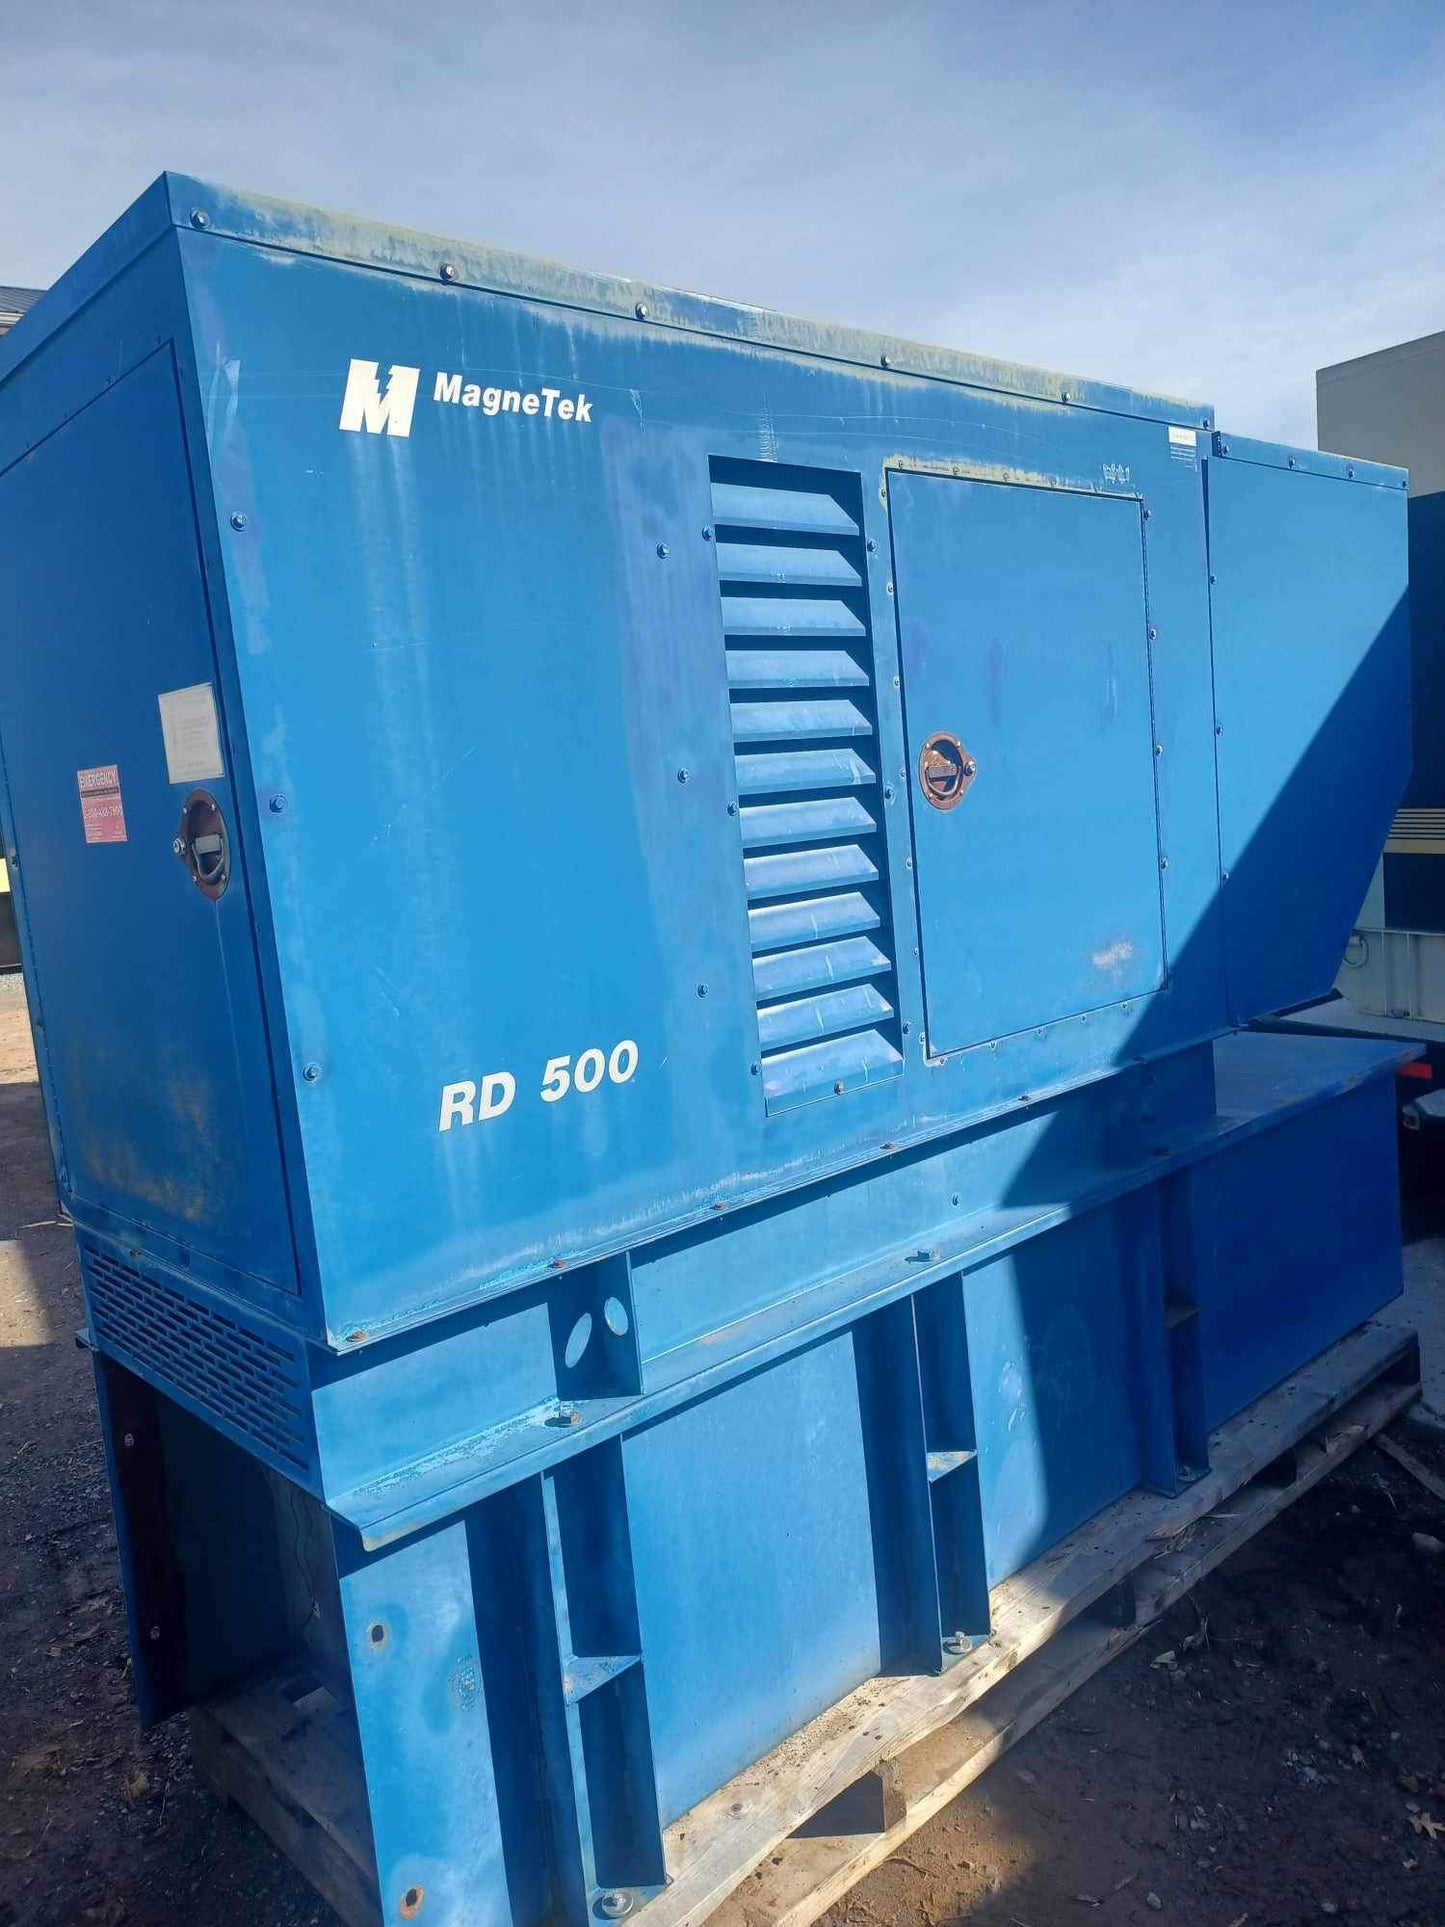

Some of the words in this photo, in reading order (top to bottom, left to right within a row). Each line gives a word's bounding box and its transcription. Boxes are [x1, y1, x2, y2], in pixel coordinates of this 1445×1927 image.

[433, 371, 593, 423] MagneTek
[438, 1071, 517, 1132] RD
[540, 1039, 639, 1102] 500
